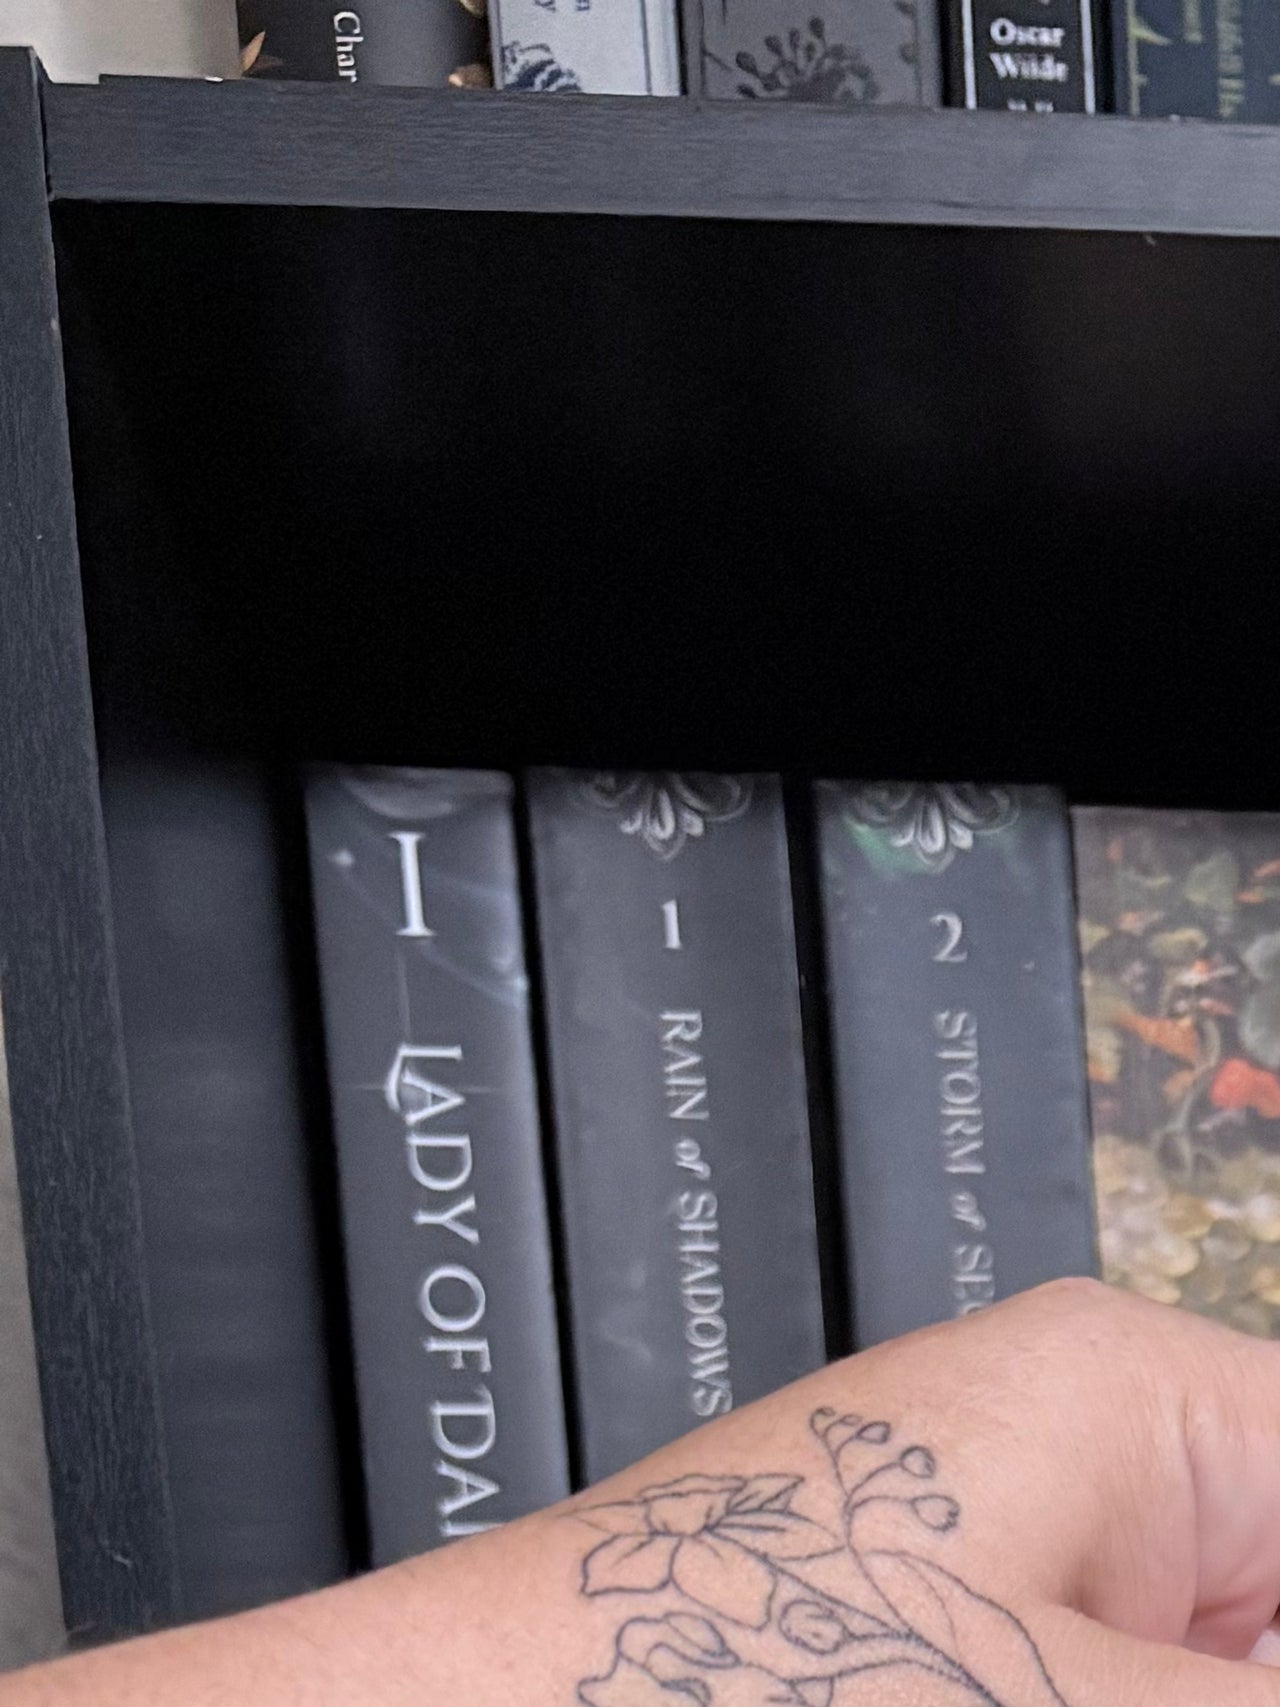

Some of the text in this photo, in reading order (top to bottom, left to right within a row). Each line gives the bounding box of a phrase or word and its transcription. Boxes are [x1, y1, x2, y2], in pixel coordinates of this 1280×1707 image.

[989, 16, 1065, 47] Oscar
[989, 52, 1069, 82] Wilde
[660, 900, 684, 950] 1
[929, 912, 967, 964] 2
[659, 1009, 710, 1121] RAIN
[934, 1009, 987, 1175] STORM
[386, 1042, 478, 1246] LADY
[418, 1263, 492, 1373] OF
[676, 1190, 734, 1418] SHADOWS
